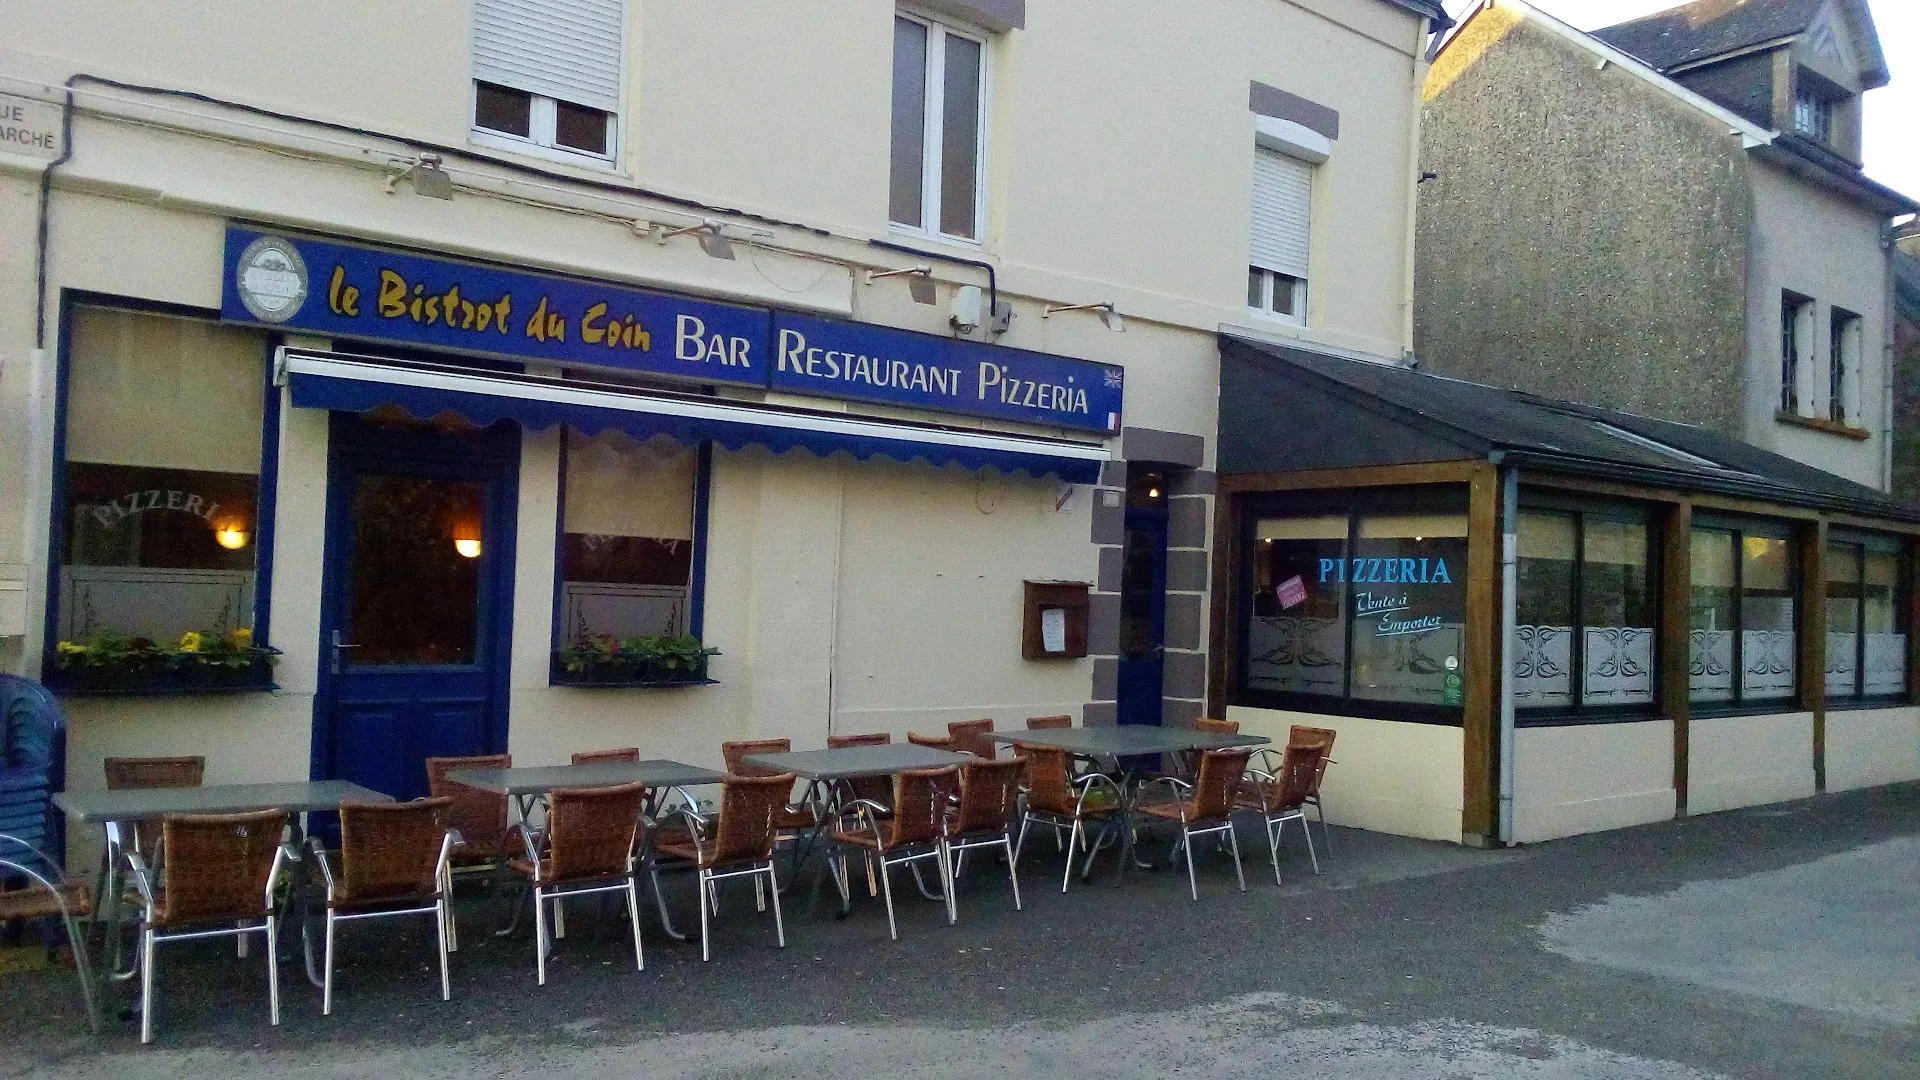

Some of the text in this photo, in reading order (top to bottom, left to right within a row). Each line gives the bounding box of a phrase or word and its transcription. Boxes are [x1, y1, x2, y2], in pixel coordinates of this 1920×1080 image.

[329, 265, 359, 317] le
[379, 270, 510, 334] Bistrot
[526, 297, 565, 342] du
[581, 303, 651, 352] Coin
[675, 314, 751, 368] BAR
[777, 328, 962, 396] RESTAURANT
[92, 489, 222, 528] PIZZERI
[1319, 557, 1452, 583] PIZZERIA
[1356, 591, 1395, 611] Vente
[1377, 613, 1442, 633] Emporter
